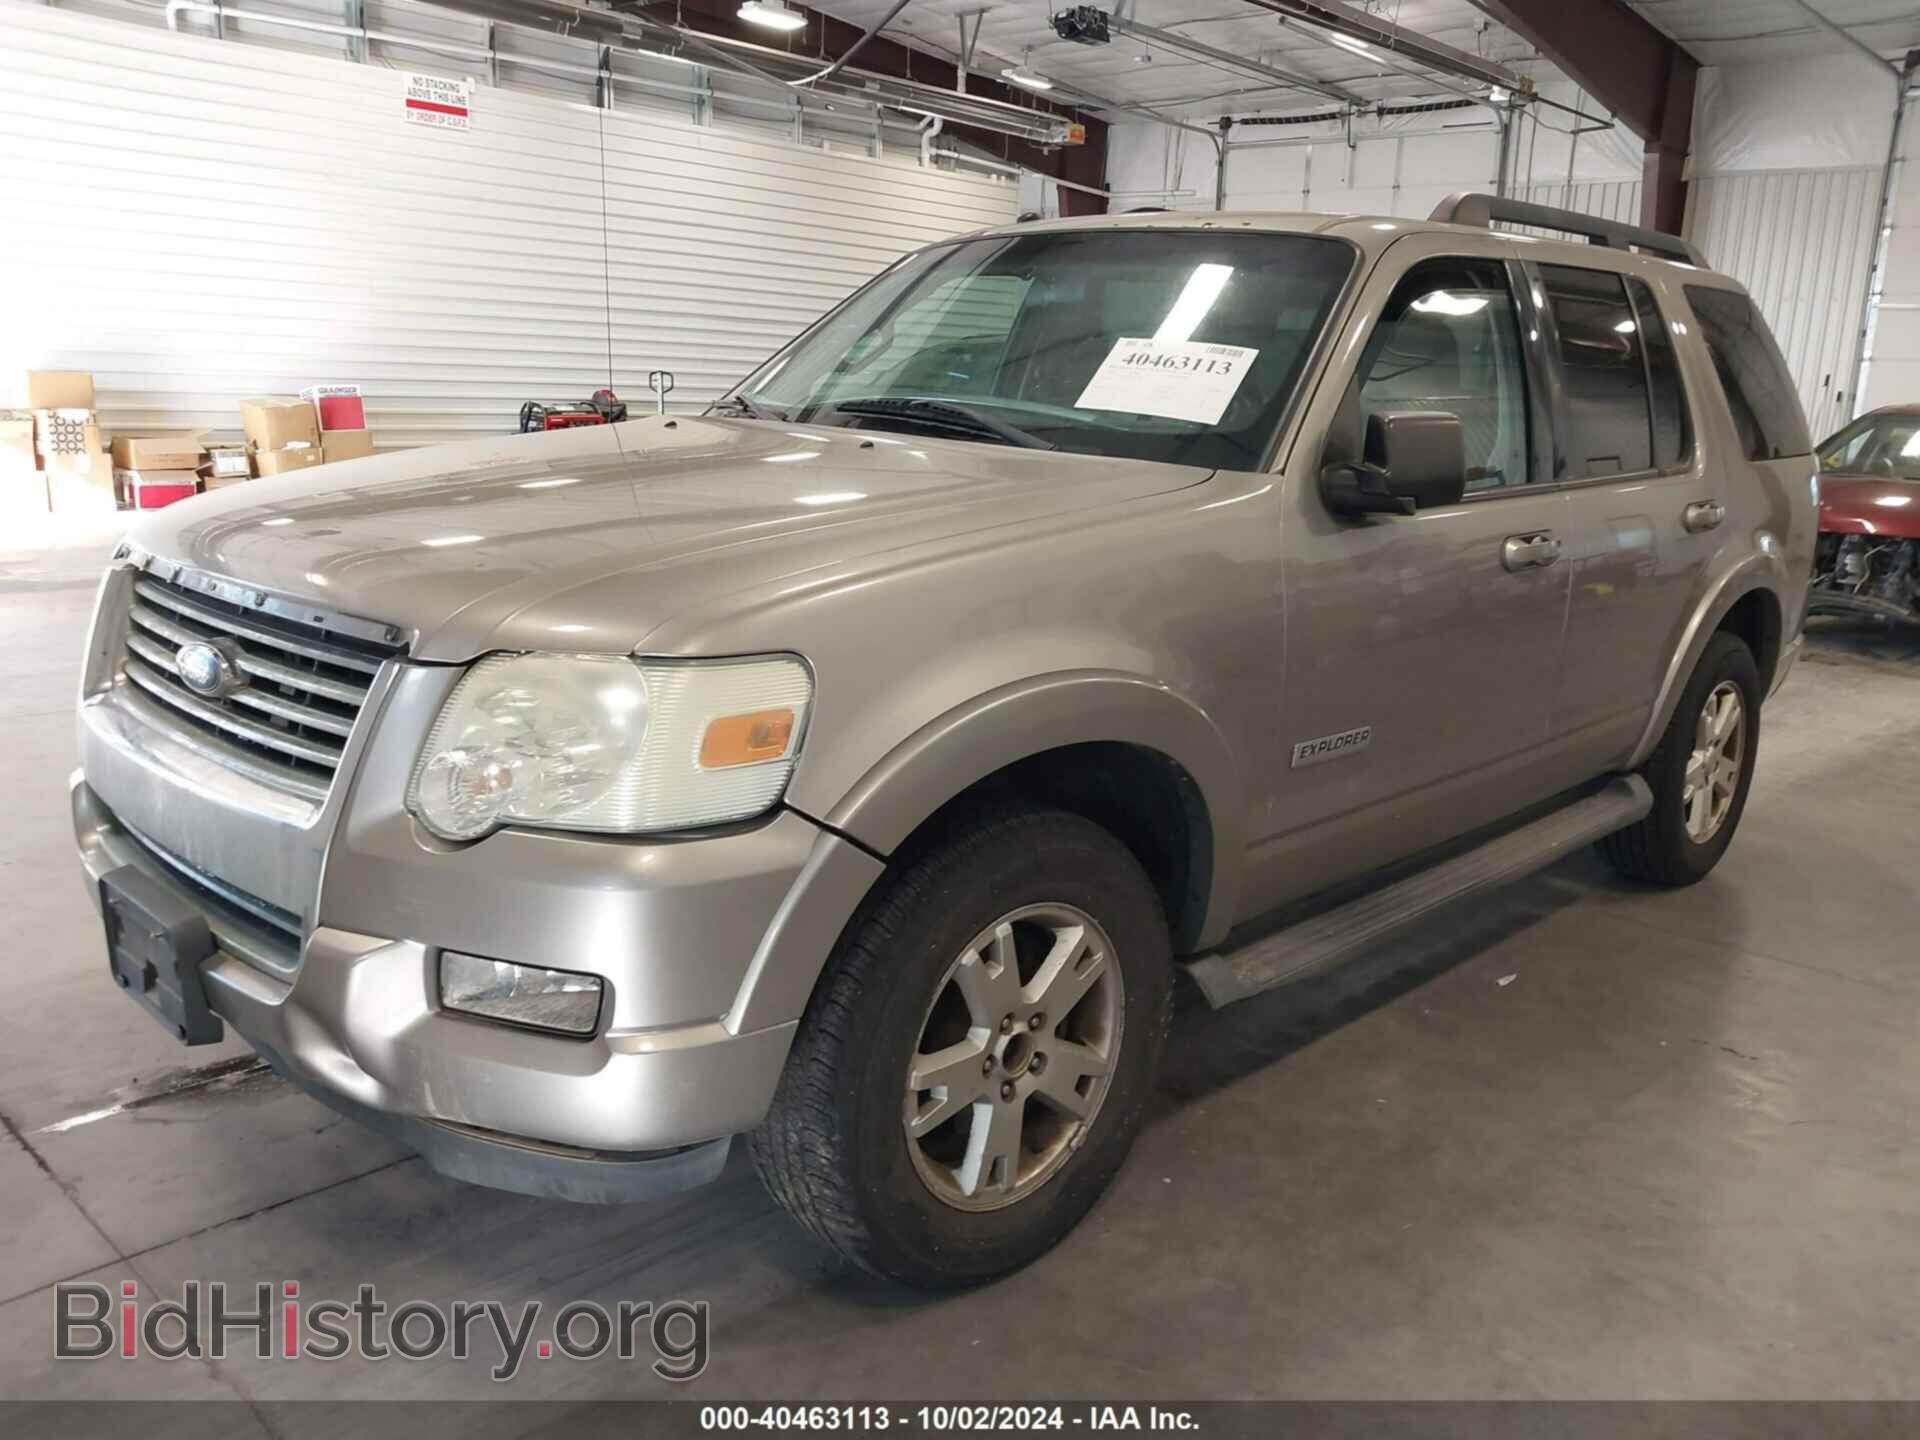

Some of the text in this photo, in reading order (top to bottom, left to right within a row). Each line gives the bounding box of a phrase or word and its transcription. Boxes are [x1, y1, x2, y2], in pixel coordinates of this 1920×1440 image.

[412, 76, 460, 93] NO STACKING
[408, 86, 466, 106] ABOVE THIS LINE
[1122, 351, 1233, 376] 40463113
[1299, 729, 1370, 760] EXPLORER
